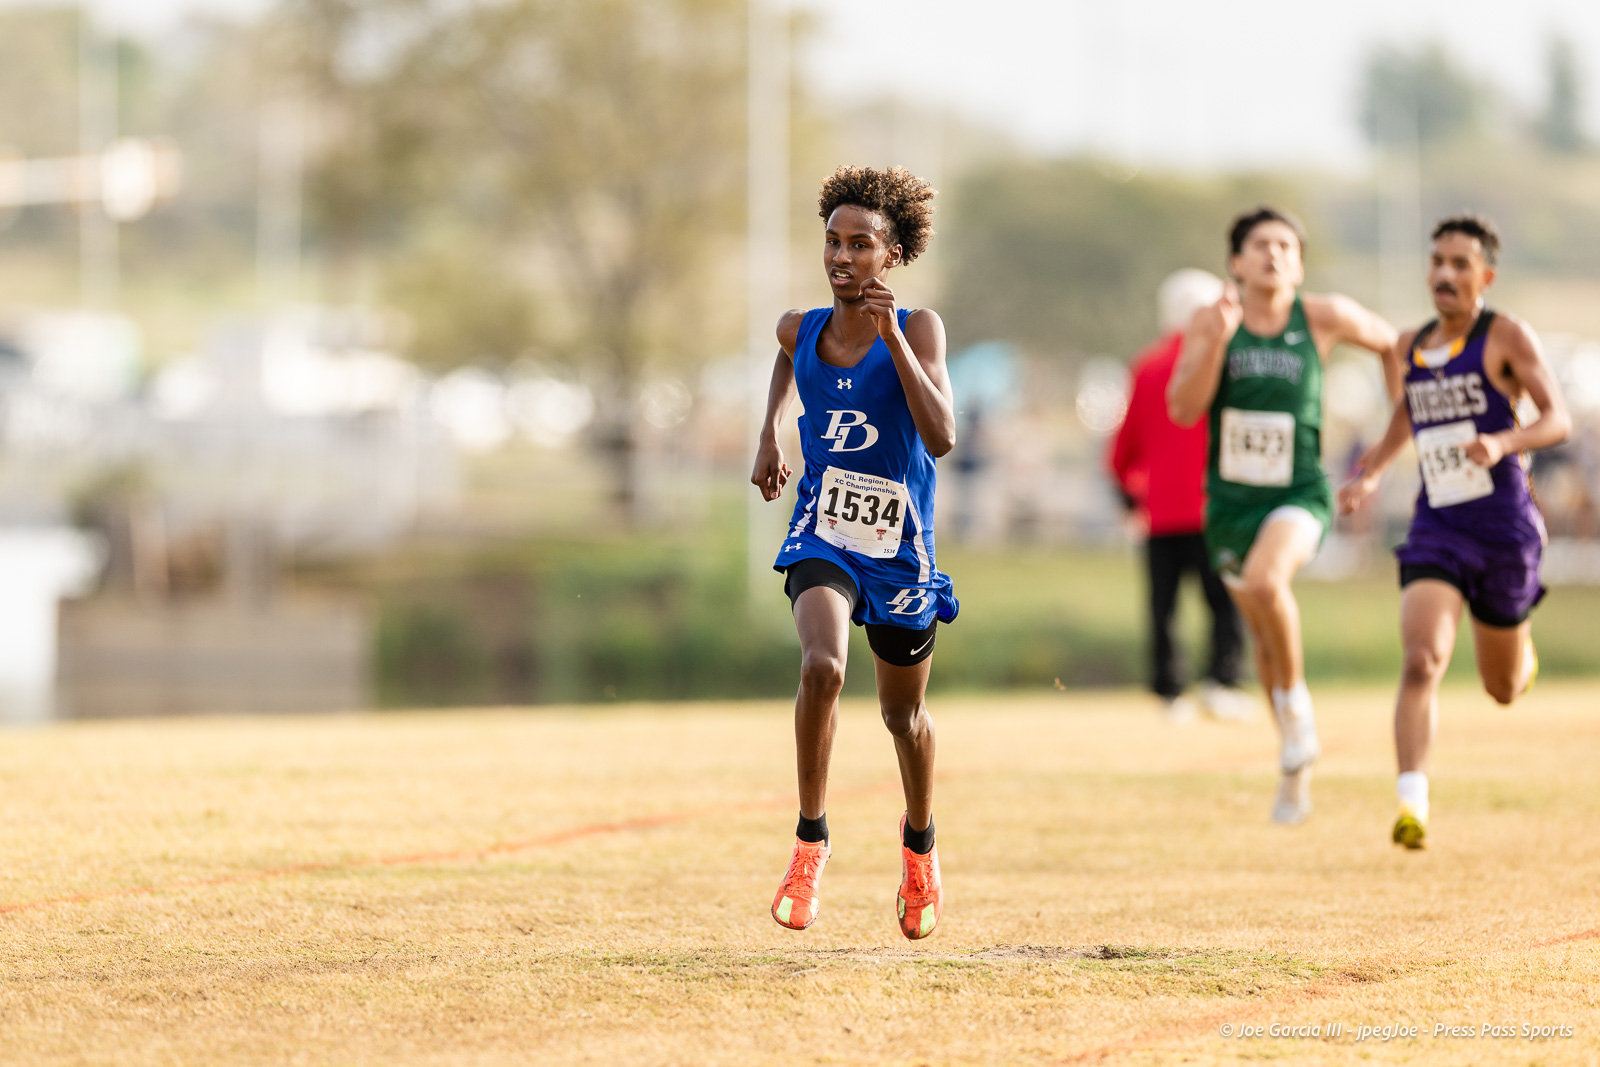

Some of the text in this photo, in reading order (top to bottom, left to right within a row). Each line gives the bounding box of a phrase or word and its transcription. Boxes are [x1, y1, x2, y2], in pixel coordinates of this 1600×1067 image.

[1424, 447, 1470, 476] 159
[834, 477, 897, 496] XC Championship
[844, 473, 857, 481] UIL
[858, 476, 884, 486] Region
[824, 486, 900, 528] 1534
